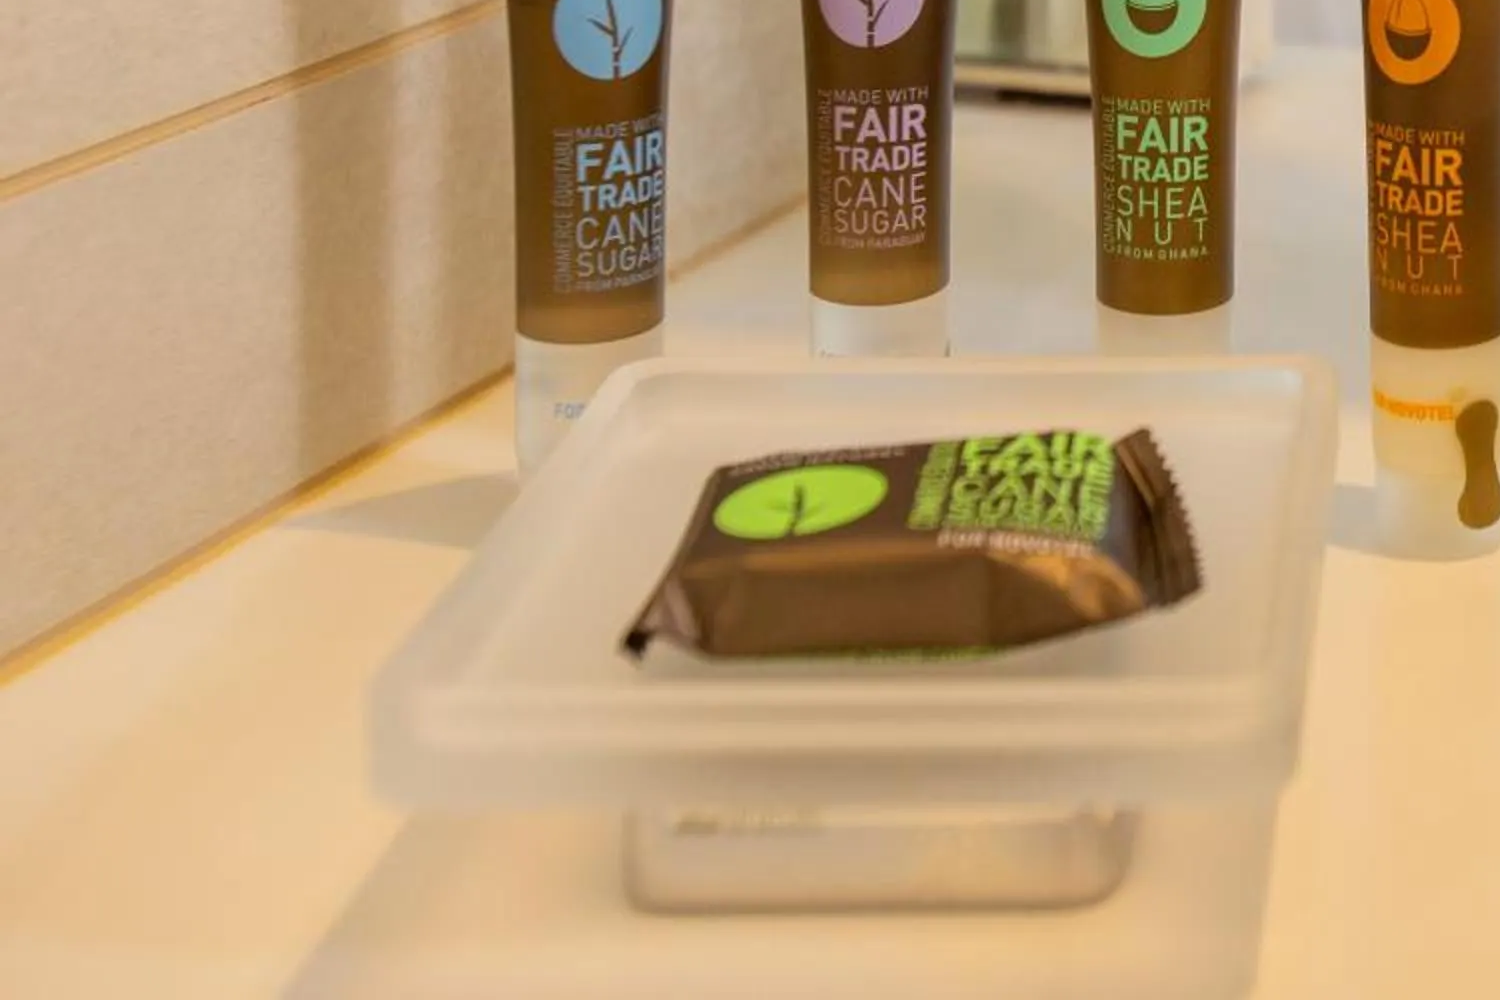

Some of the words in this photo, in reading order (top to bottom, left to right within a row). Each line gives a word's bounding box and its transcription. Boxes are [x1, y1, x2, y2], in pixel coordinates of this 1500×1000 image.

[833, 89, 882, 105] MADE
[885, 85, 929, 103] WITH
[1117, 98, 1163, 115] MADE
[1166, 97, 1211, 115] WITH
[575, 120, 630, 140] MADE
[833, 103, 928, 144] FAIR
[1116, 115, 1209, 153] FAIR
[1374, 121, 1415, 145] MADE
[1419, 127, 1466, 146] WITH
[575, 128, 664, 183] FAIR
[835, 142, 928, 174] TRADE
[1118, 153, 1210, 182] TRADE
[1374, 139, 1464, 188] FAIR
[577, 170, 664, 213] TRADE
[833, 171, 928, 209] CANE
[1117, 184, 1209, 220] SHEA
[1376, 179, 1465, 216] TRADE
[575, 200, 663, 251] CANE
[833, 203, 927, 235] SUGAR
[1102, 172, 1115, 253] COMMERCE
[1376, 211, 1464, 254] SHEA
[576, 234, 664, 279] SUGAR
[961, 431, 1114, 467] FAIR
